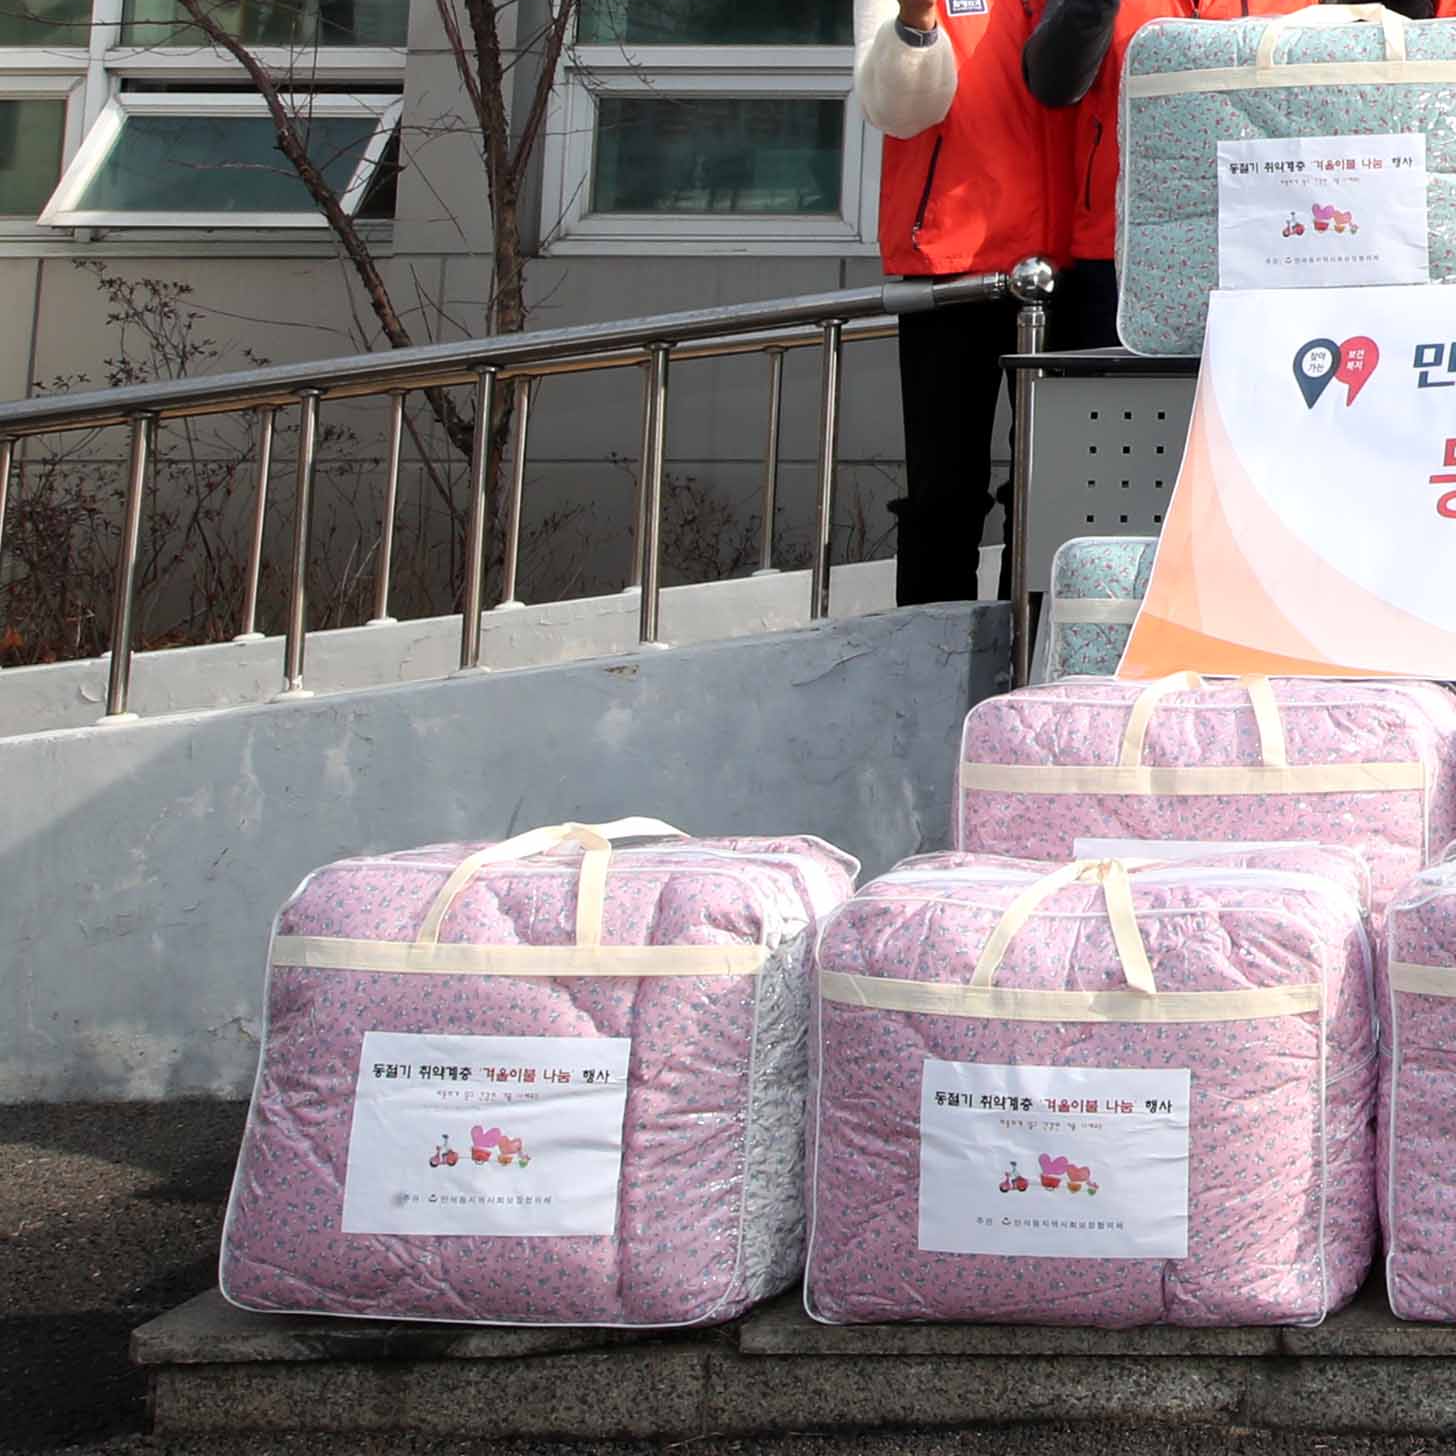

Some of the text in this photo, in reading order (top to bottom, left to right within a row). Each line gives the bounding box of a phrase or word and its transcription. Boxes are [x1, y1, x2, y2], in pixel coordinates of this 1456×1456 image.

[372, 1064, 411, 1079] 동절기
[419, 1065, 472, 1080] 취약계층
[582, 1068, 610, 1084] 행사
[934, 1092, 973, 1107] 동절기
[980, 1095, 1032, 1112] 취약계층
[1145, 1100, 1172, 1114] 행사
